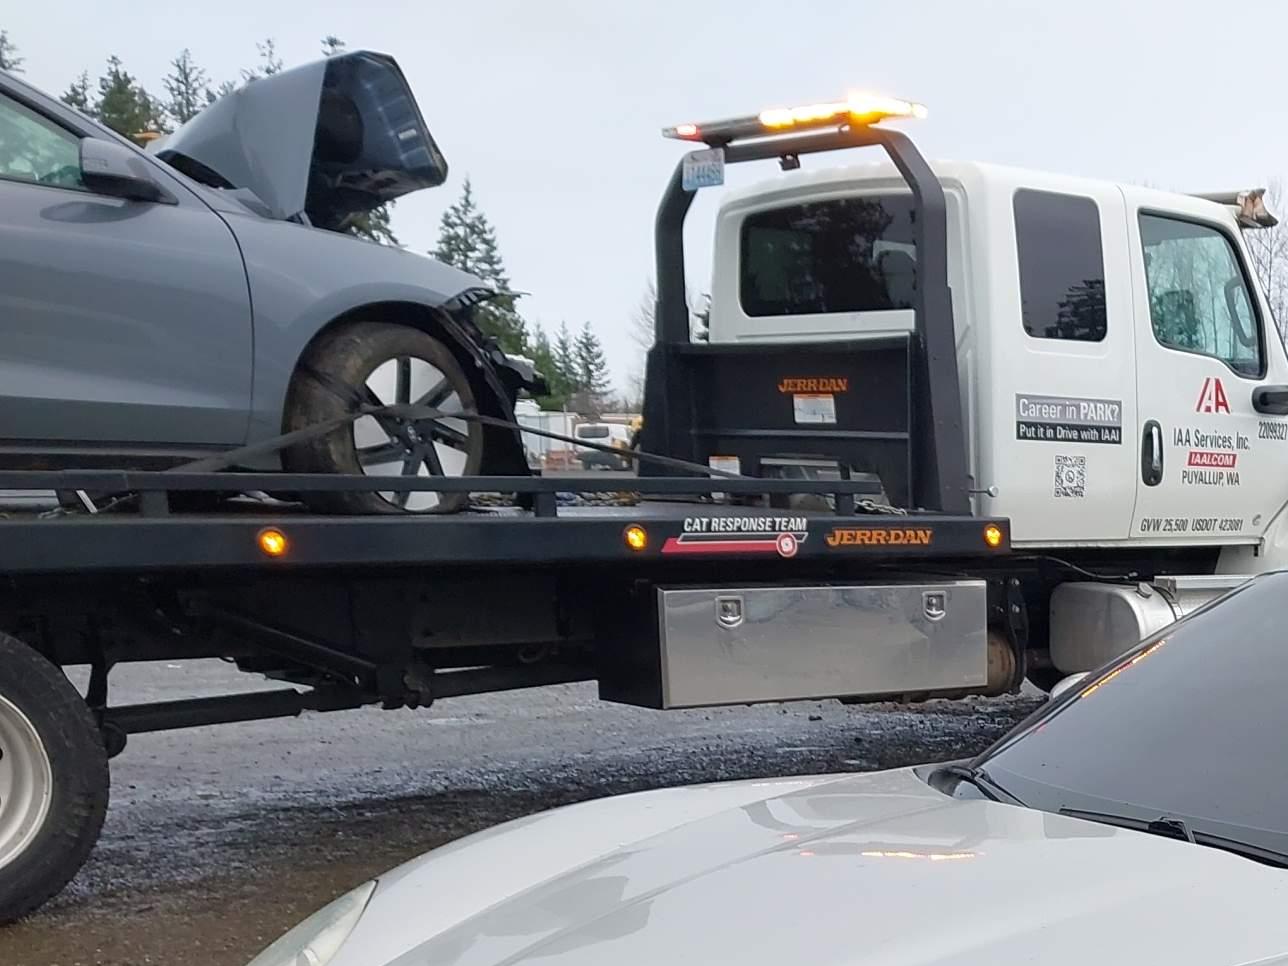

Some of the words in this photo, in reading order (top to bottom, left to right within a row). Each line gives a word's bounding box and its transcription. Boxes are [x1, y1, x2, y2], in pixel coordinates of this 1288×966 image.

[1019, 398, 1062, 418] Career
[1066, 401, 1077, 419] in
[1080, 402, 1120, 421] PARK?
[1019, 424, 1037, 438] Put
[1037, 425, 1046, 438] it
[1046, 425, 1054, 438] in
[1056, 426, 1079, 439] Drive
[1080, 427, 1099, 440] with
[1173, 428, 1192, 447] IAA
[1194, 430, 1235, 451] Services,
[1236, 432, 1251, 450] Inc.
[1182, 470, 1224, 487] PUYALLUP,
[1226, 472, 1240, 486] WA
[683, 518, 708, 532] CAT
[710, 518, 774, 531] RESPONSE
[774, 518, 807, 531] TEAM
[1140, 518, 1163, 531] GVW
[1162, 519, 1188, 532] 25,500
[1191, 519, 1218, 531] USDOT
